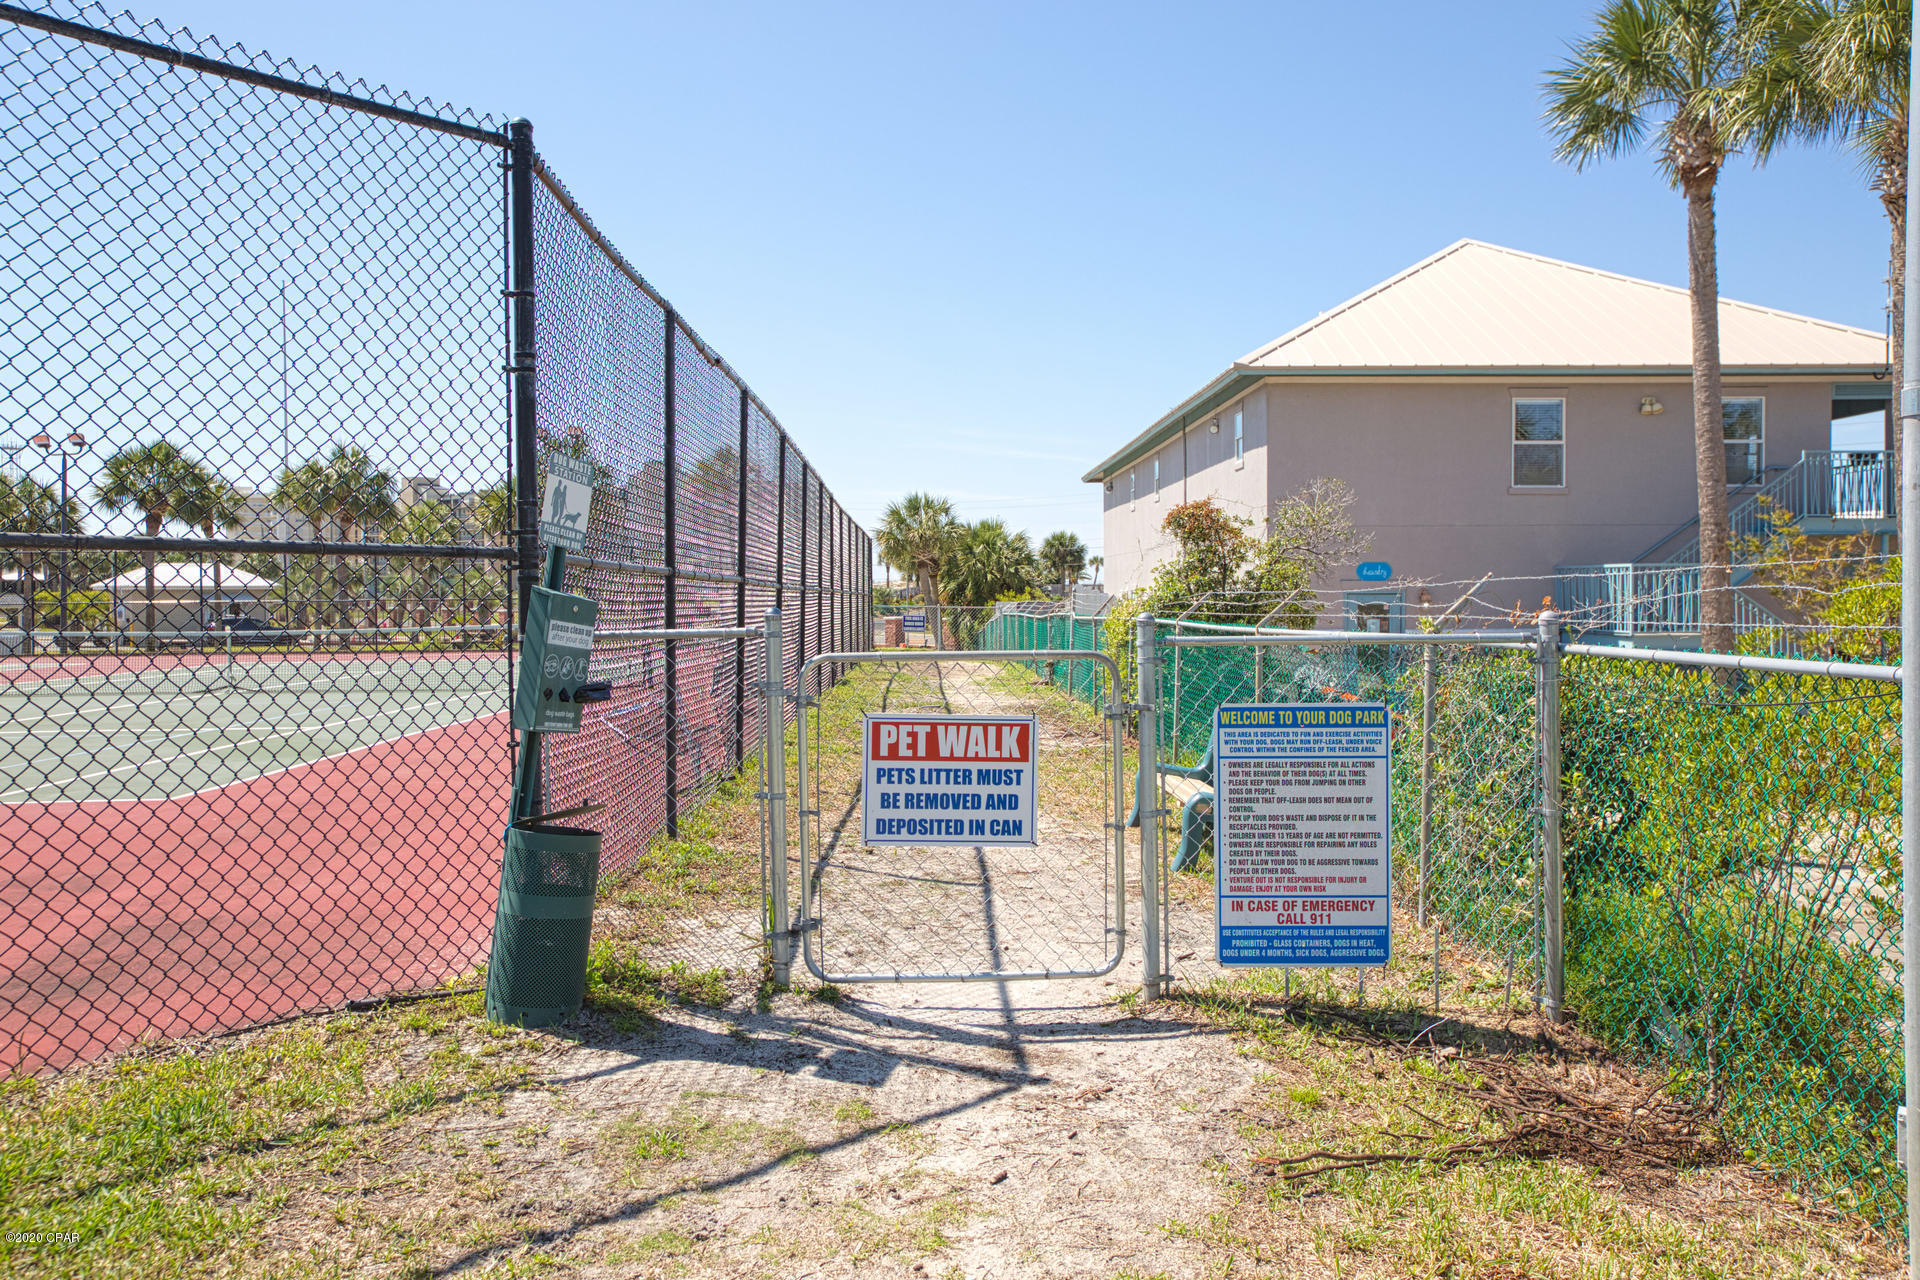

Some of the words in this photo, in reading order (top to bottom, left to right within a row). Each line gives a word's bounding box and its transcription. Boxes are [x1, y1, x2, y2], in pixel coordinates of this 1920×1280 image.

[568, 459, 591, 475] WASTE
[554, 466, 588, 484] STATION
[551, 622, 570, 633] please
[570, 625, 584, 636] clean
[585, 628, 592, 637] up
[551, 633, 565, 642] after
[565, 636, 577, 645] your
[578, 636, 589, 646] dog
[1220, 710, 1275, 725] WELCOME
[1280, 710, 1293, 725] TO
[1297, 710, 1326, 725] YOUR
[1329, 710, 1352, 725] DOG
[1356, 710, 1385, 725] PARK
[880, 724, 931, 758] PET
[938, 724, 1020, 758] WALK
[1228, 760, 1252, 769] OWNERS
[1253, 760, 1264, 769] ARE
[1265, 760, 1288, 769] LEGALLY
[1289, 760, 1327, 769] RESPONSIBLE
[1328, 760, 1339, 769] FOR
[1340, 760, 1350, 769] ALL
[1351, 760, 1375, 769] ACTIONS
[876, 768, 916, 786] PETS
[920, 768, 973, 786] LITTER
[977, 768, 1024, 786] MUST
[1229, 770, 1240, 778] AND
[1241, 770, 1252, 778] THE
[1253, 770, 1281, 778] BEHAVIOR
[1282, 770, 1289, 778] OF
[1291, 770, 1307, 778] THEIR
[1308, 770, 1328, 778] DOG(S)
[1329, 770, 1336, 778] AT
[1337, 770, 1347, 778] ALL
[1349, 770, 1367, 778] TIMES.
[1228, 778, 1249, 787] PLEASE
[1250, 778, 1264, 787] KEEP
[1266, 778, 1281, 787] YOUR
[1281, 778, 1293, 787] DOG
[1294, 778, 1311, 787] FROM
[1312, 778, 1337, 787] JUMPING
[1338, 778, 1347, 787] ON
[1348, 778, 1366, 787] OTHER
[880, 792, 900, 810] BE
[904, 792, 982, 810] REMOVED
[986, 792, 1019, 810] AND
[876, 818, 965, 836] DEPOSITED
[969, 818, 986, 836] IN
[990, 818, 1023, 836] CAN
[1232, 900, 1244, 912] IN
[1248, 900, 1278, 912] CASE
[1282, 900, 1297, 912] OF
[1302, 900, 1375, 912] EMERGENCY
[1277, 912, 1306, 925] CALL
[1310, 912, 1331, 925] 911
[1232, 939, 1268, 948] PROHIBITED
[1273, 939, 1292, 948] GLASS
[1334, 939, 1350, 948] DOGS
[1351, 939, 1358, 948] IN
